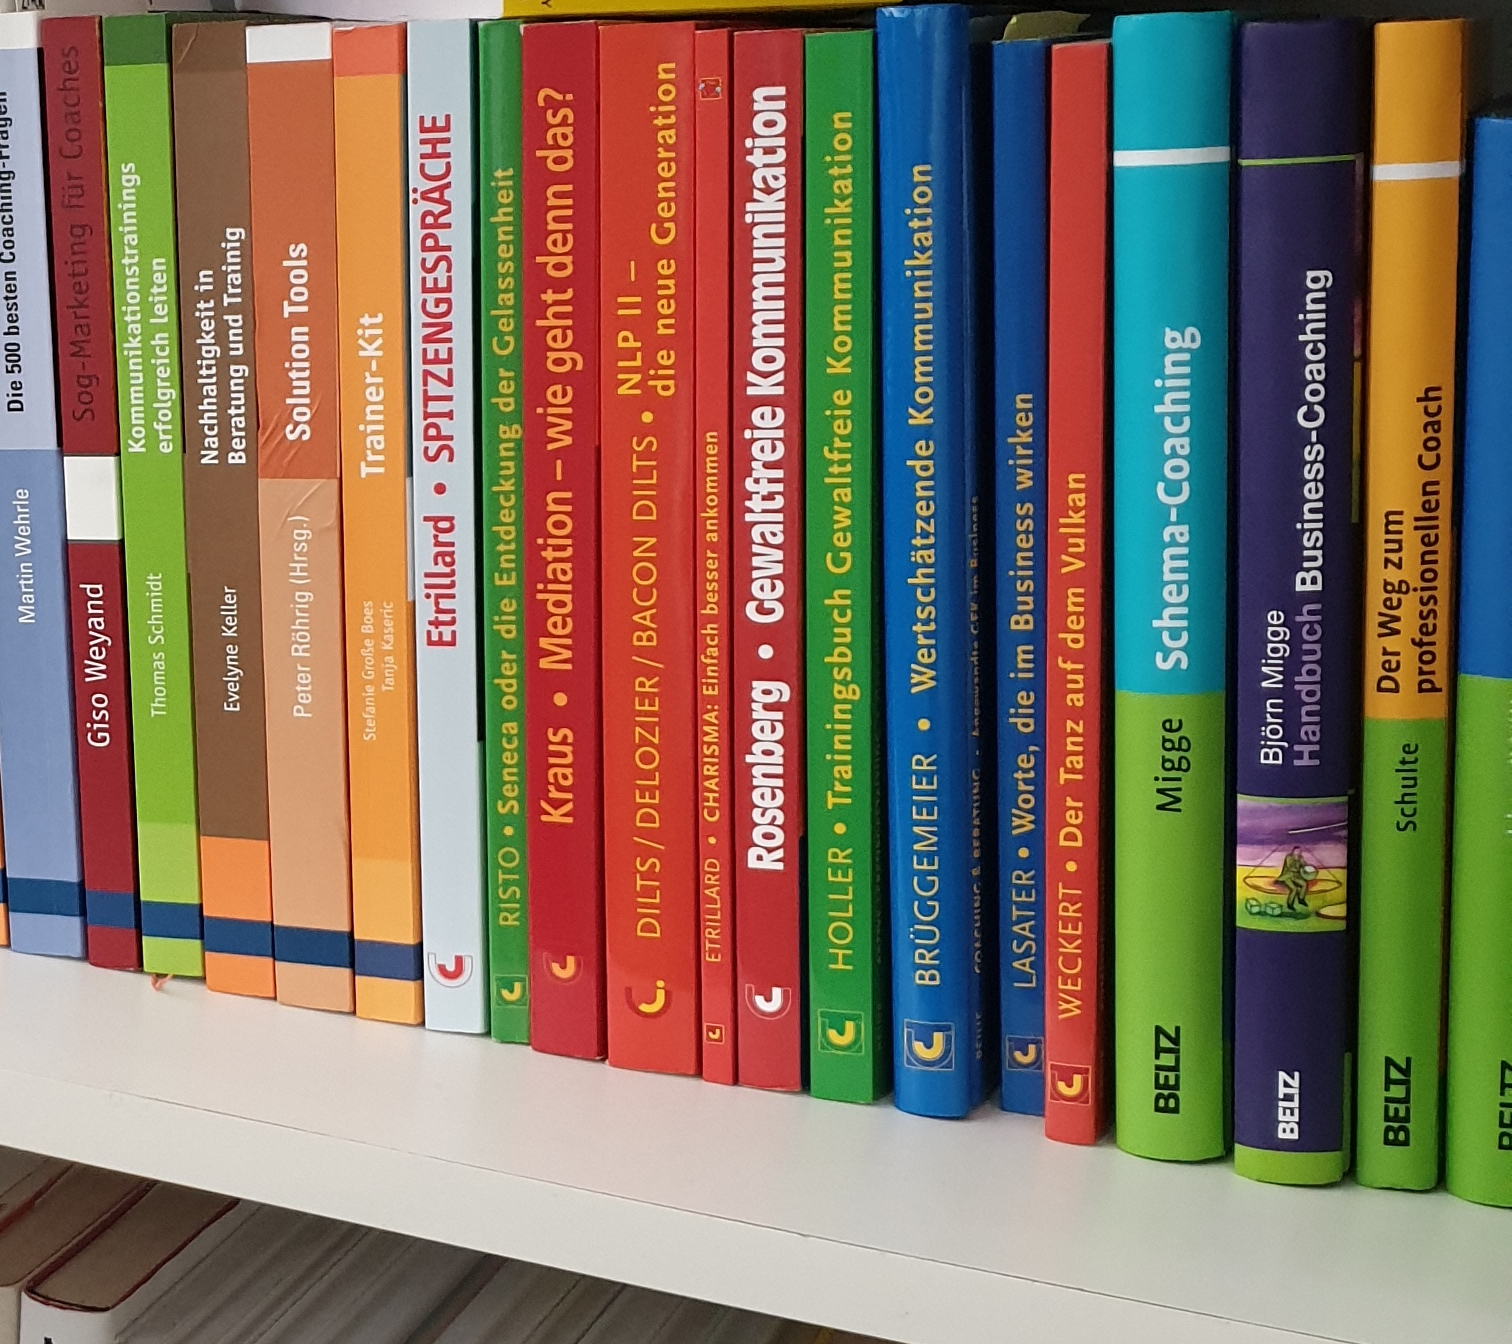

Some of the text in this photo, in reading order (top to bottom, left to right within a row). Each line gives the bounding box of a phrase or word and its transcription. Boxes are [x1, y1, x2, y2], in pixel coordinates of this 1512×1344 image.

[0, 272, 21, 335] besten
[3, 344, 22, 375] 500
[6, 381, 25, 413] Die
[119, 162, 148, 454] Kommunikationstrainings
[146, 256, 179, 455] erfolgreich leiten
[282, 243, 313, 441] Solution Tools
[358, 313, 387, 478] Trainer-Kit
[415, 114, 459, 649] Etrillard SPITZENGESPRÄCHE
[538, 87, 582, 823] Kraus Mediation wie geht denn das?
[745, 87, 791, 870] Rosenberg Gewaltfreie Kommunikation
[824, 111, 860, 969] HOLLER Trainingsbuch Gewaltfreie Kommunikation
[905, 163, 941, 987] BRÜGGEMEIER Wertschätzende Kommunikation
[1293, 269, 1334, 767] Handbuch Business-Coaching
[79, 583, 113, 747] Giso Weyand
[1152, 327, 1201, 1115] BELTZ Migge Schema-Coaching
[1275, 1072, 1301, 1140] BELTZ
